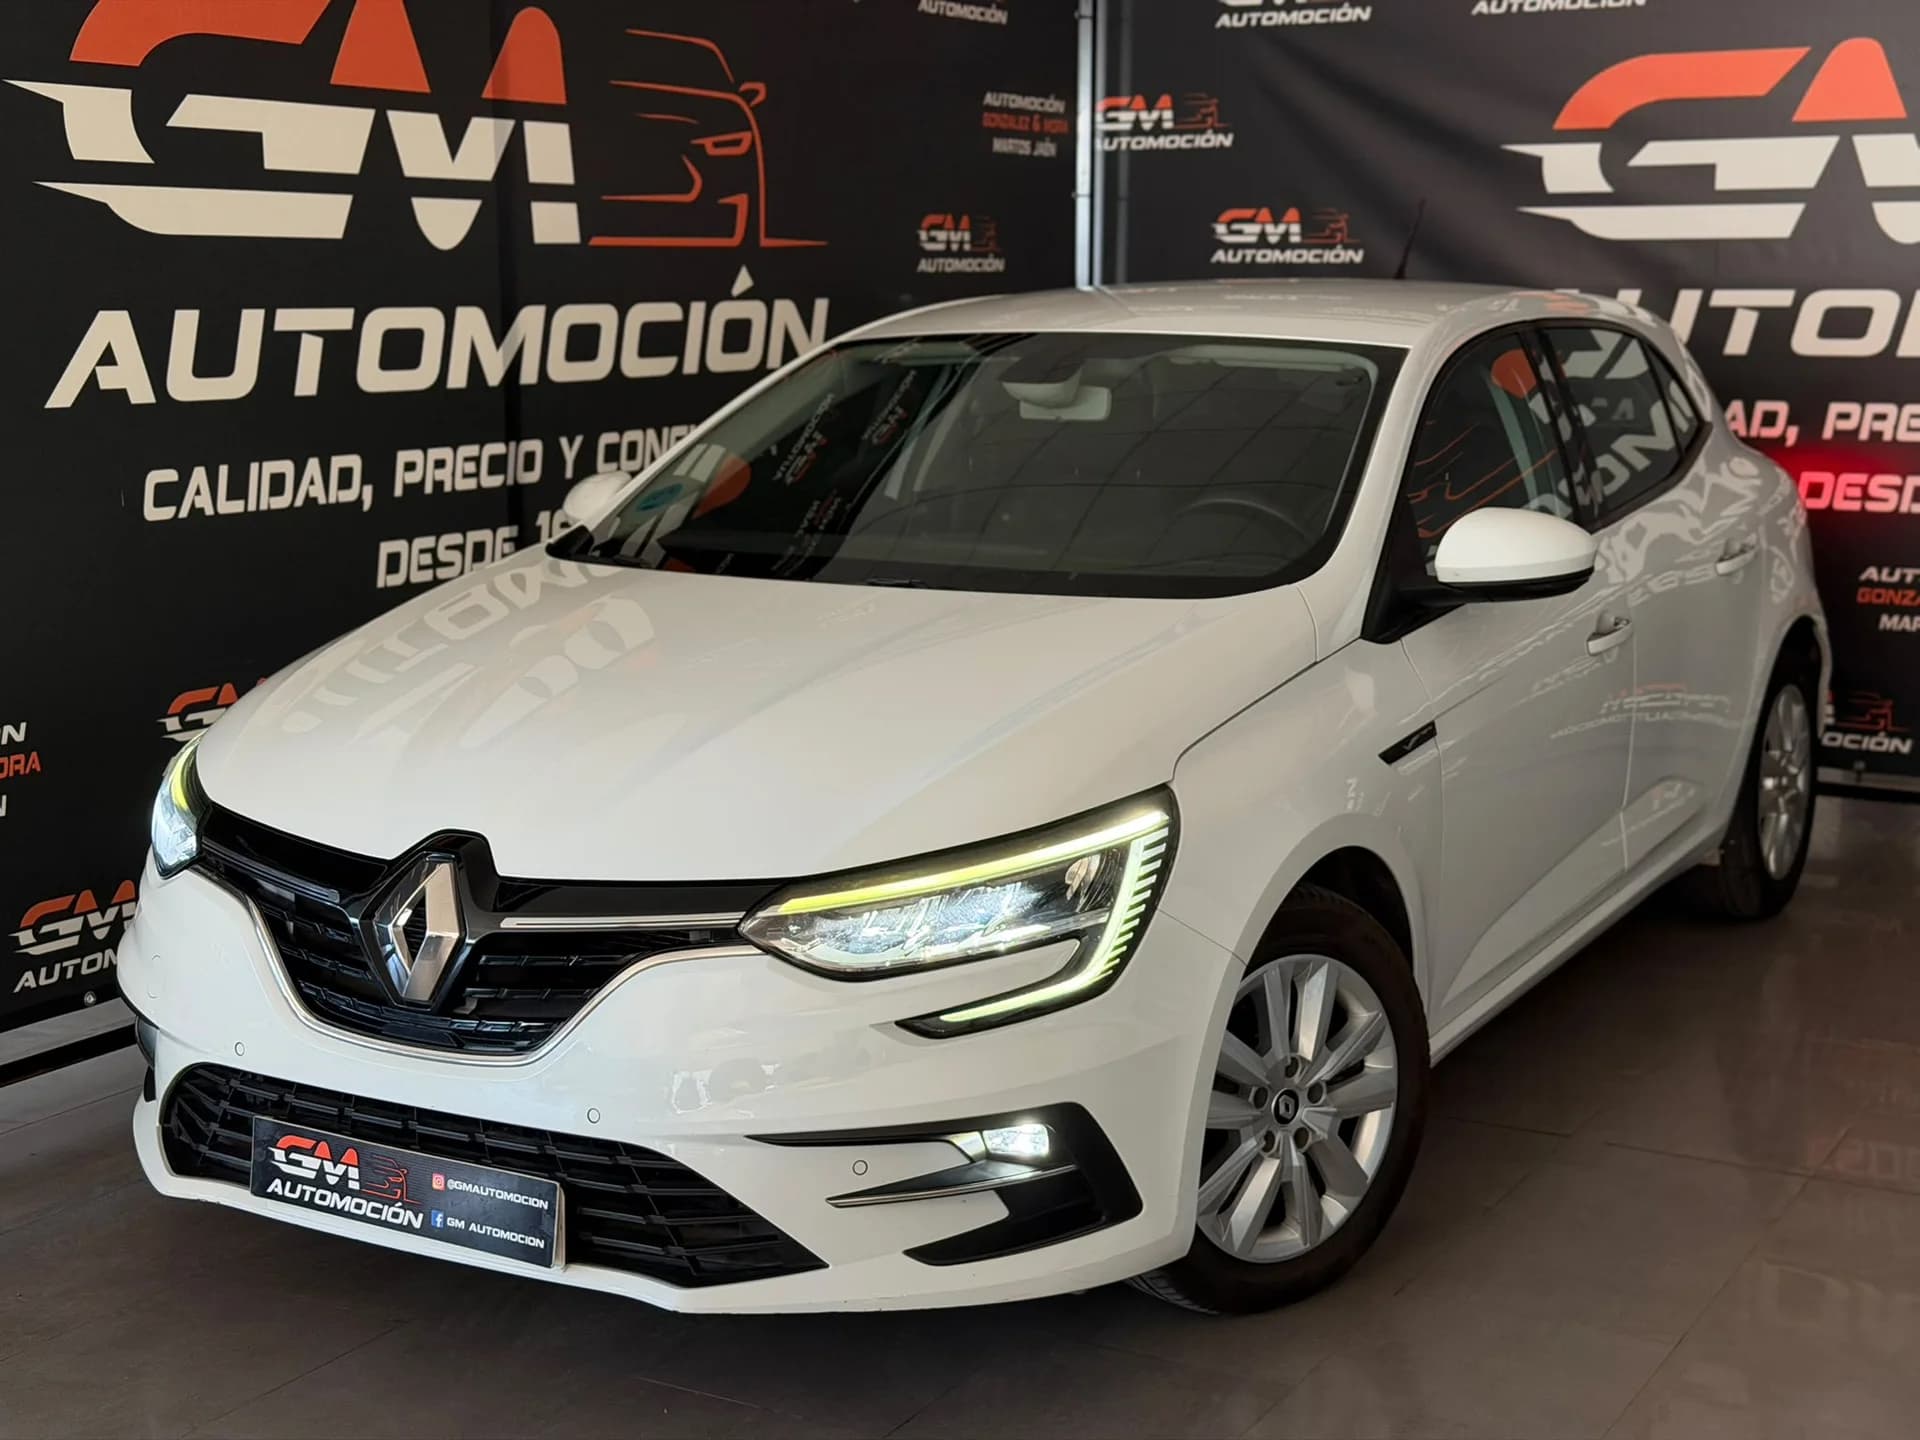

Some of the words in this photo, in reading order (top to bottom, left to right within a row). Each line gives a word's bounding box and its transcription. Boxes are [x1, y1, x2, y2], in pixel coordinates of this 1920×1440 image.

[1215, 2, 1373, 29] AUTOMOCIÓN
[983, 91, 1065, 114] AUTOMOCIÓN
[917, 212, 971, 252] GM
[1211, 207, 1302, 245] GM
[917, 253, 1005, 272] AUTOMOCIÓN
[1210, 244, 1365, 264] AUTOMOCIÓN
[44, 264, 830, 409] AUTOMOCIÓN
[143, 454, 373, 522] CALIDAD,
[393, 438, 543, 498] PRECIO
[559, 434, 584, 480] Y
[376, 525, 519, 588] DESDE
[267, 1134, 361, 1190] GM
[266, 1178, 424, 1229] AUTOMOCIÓN
[446, 1178, 549, 1210] @GMAUTOMOCION
[446, 1217, 465, 1230] GM
[468, 1222, 545, 1248] AUTOMOCION
